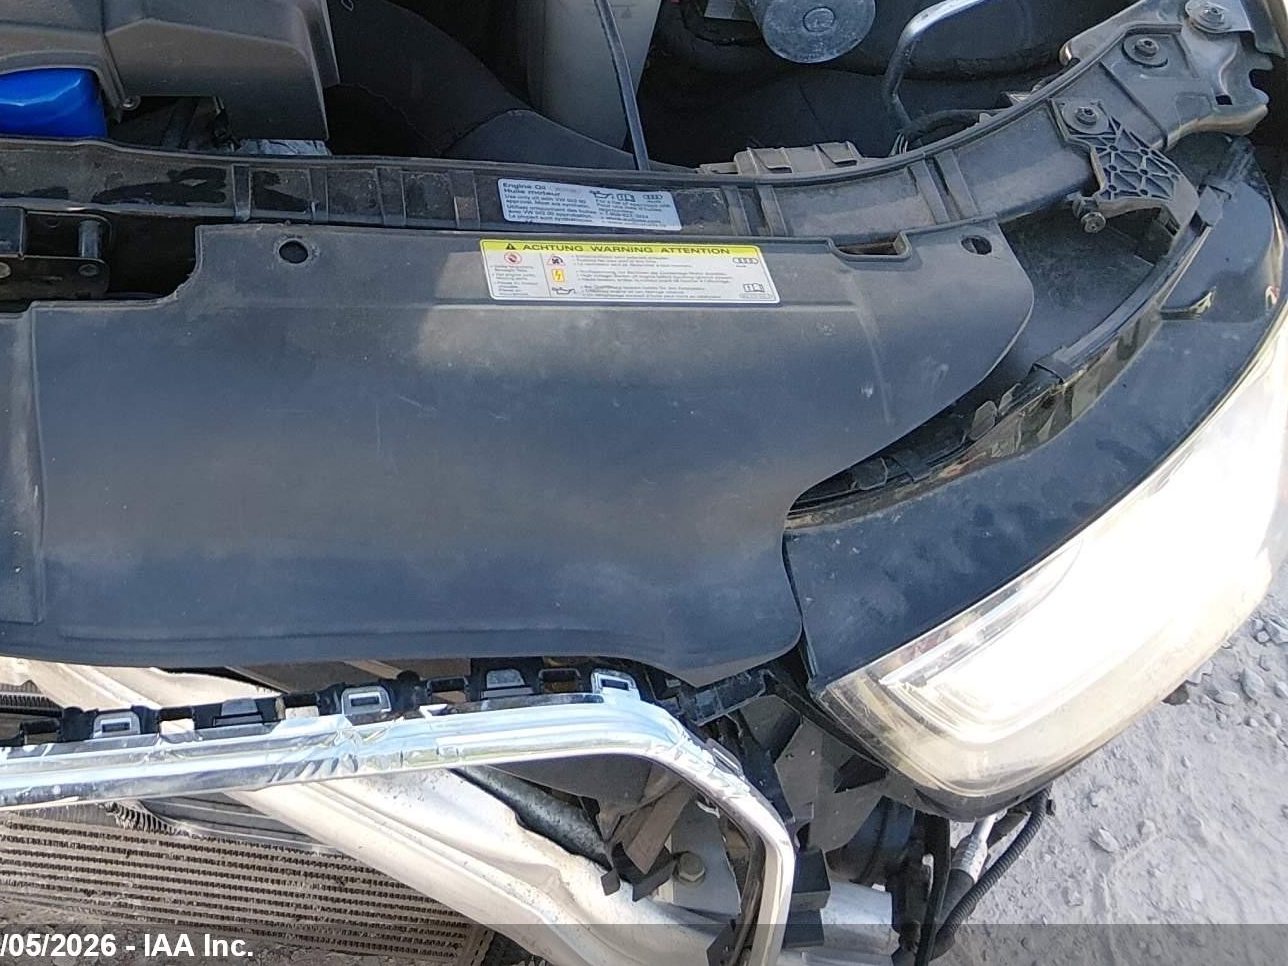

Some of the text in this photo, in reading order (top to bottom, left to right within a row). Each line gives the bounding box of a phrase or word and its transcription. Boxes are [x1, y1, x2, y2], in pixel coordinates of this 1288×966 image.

[503, 182, 532, 190] Engine
[522, 244, 584, 252] ACHTUNG
[660, 247, 731, 255] ATTENTION
